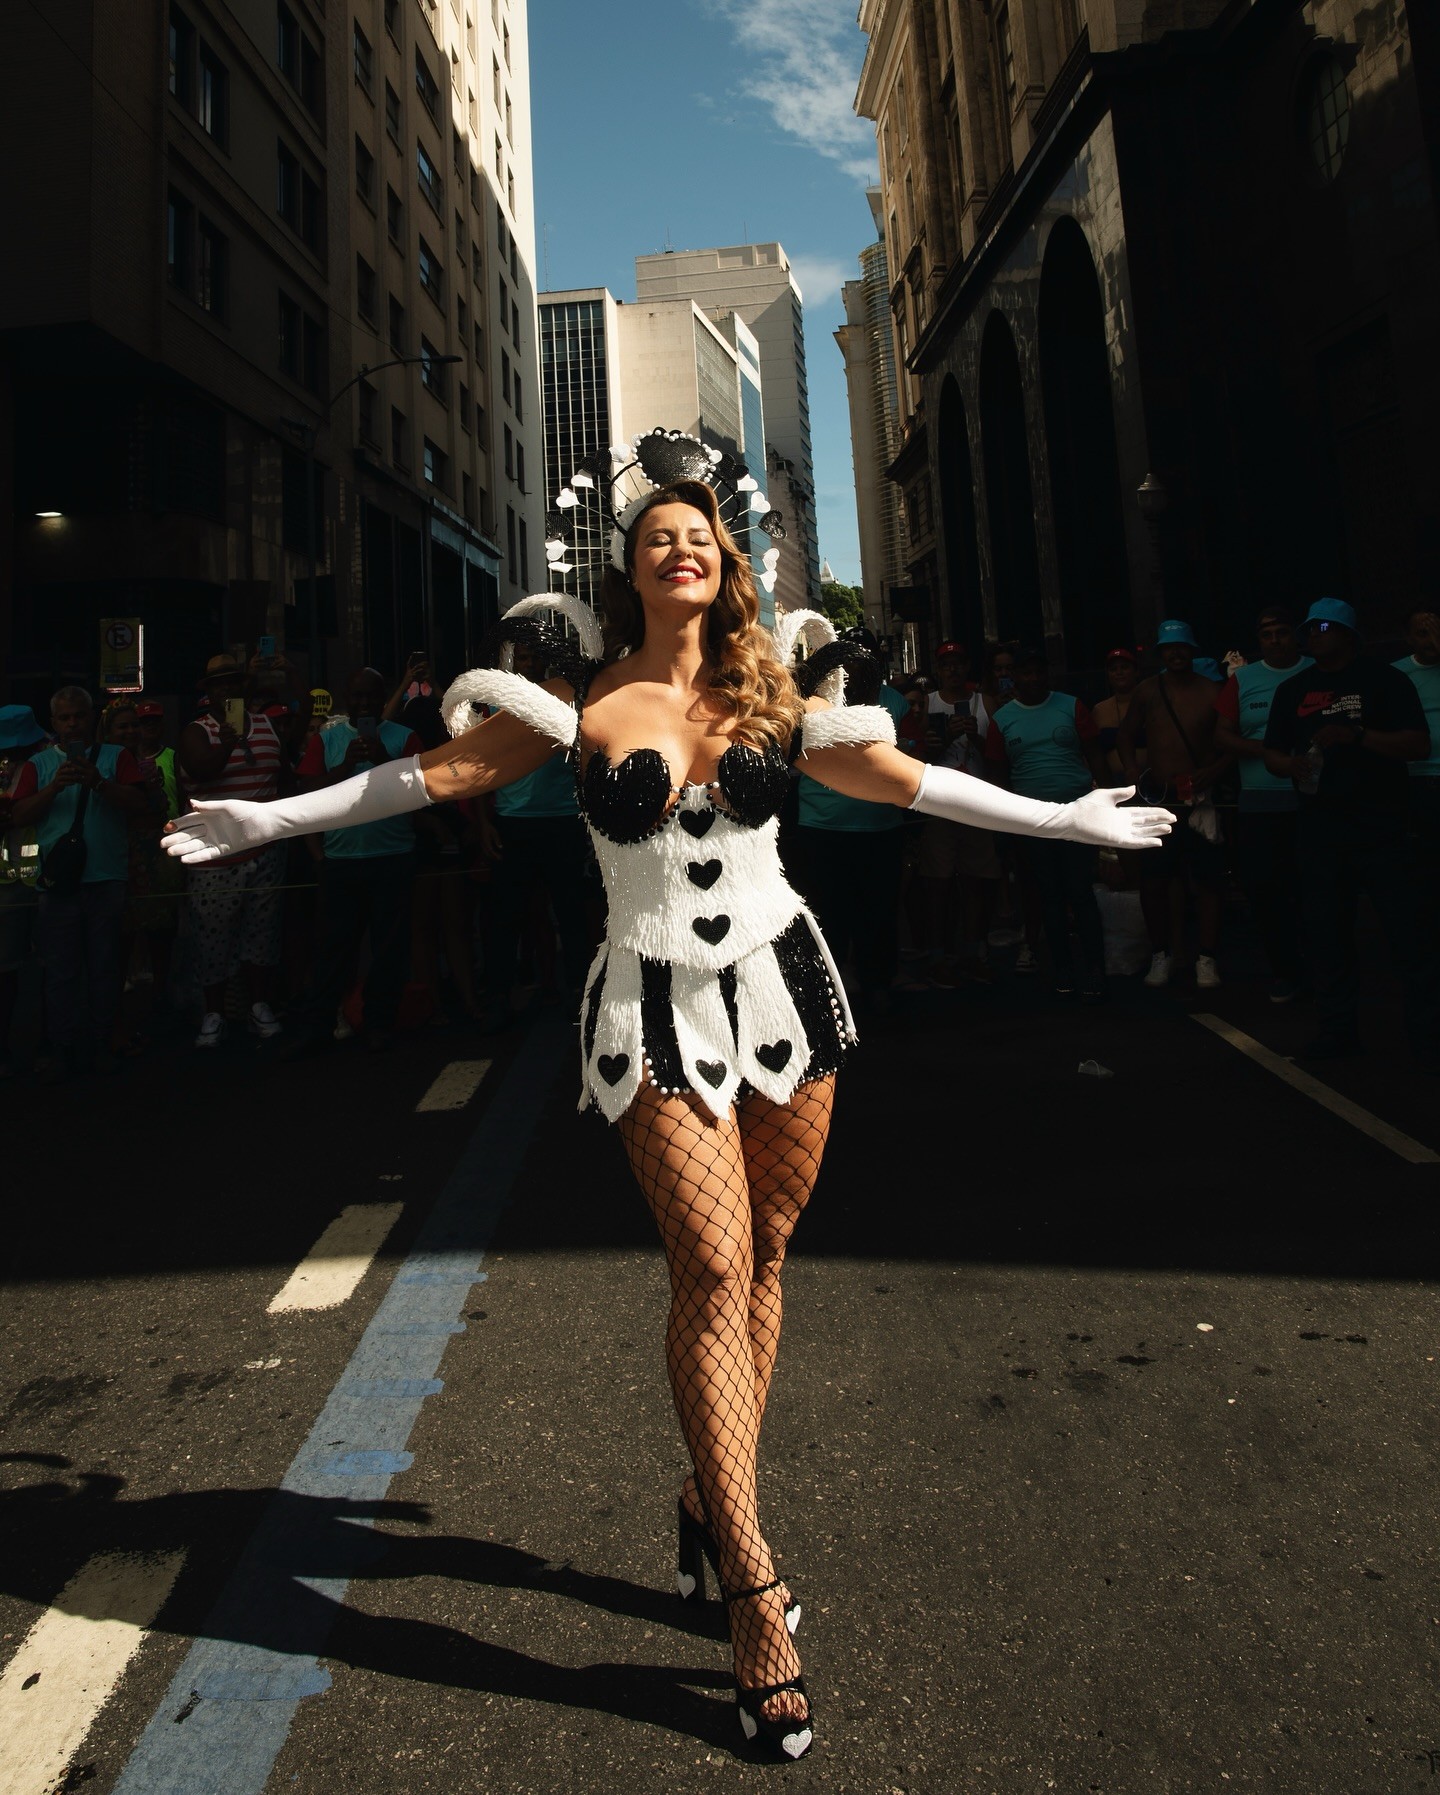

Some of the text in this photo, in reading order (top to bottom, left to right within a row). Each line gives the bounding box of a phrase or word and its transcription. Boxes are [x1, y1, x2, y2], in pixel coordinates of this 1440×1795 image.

[1303, 691, 1334, 704] NIKE
[1331, 699, 1361, 709] NATIONAL
[1322, 706, 1342, 715] BEACH
